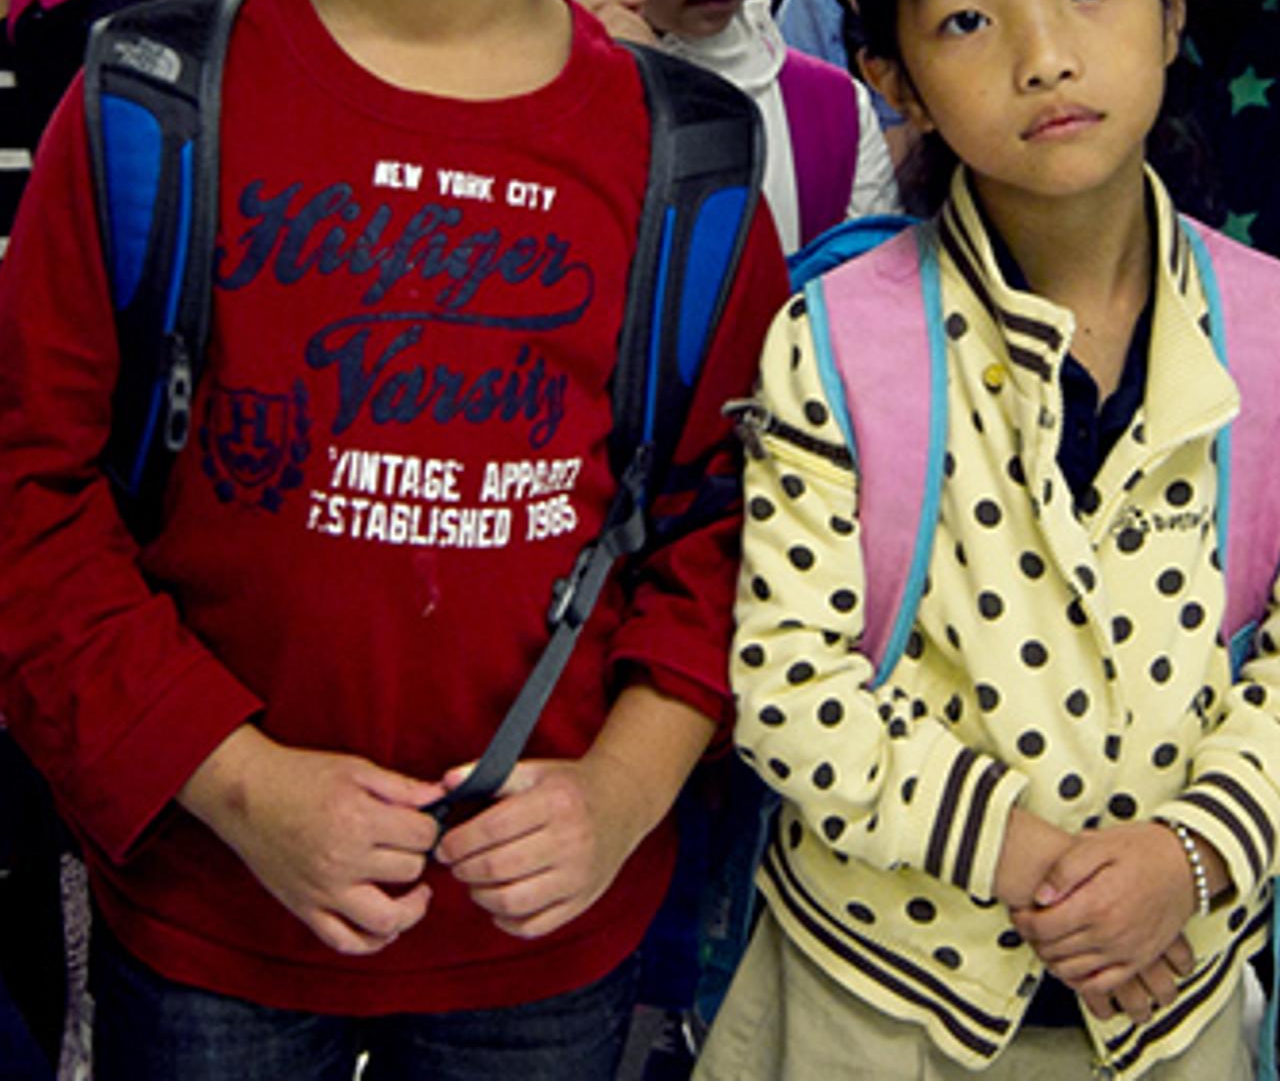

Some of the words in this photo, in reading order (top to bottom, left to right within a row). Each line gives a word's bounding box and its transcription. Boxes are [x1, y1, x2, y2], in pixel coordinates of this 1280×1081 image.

[373, 160, 423, 191] NEW
[437, 168, 496, 203] YORK
[505, 178, 557, 212] CITY
[214, 180, 586, 315] Hilfiger
[305, 322, 568, 449] Varsity
[328, 446, 465, 502] VINTAGE
[306, 489, 513, 549] ESTABLISHED
